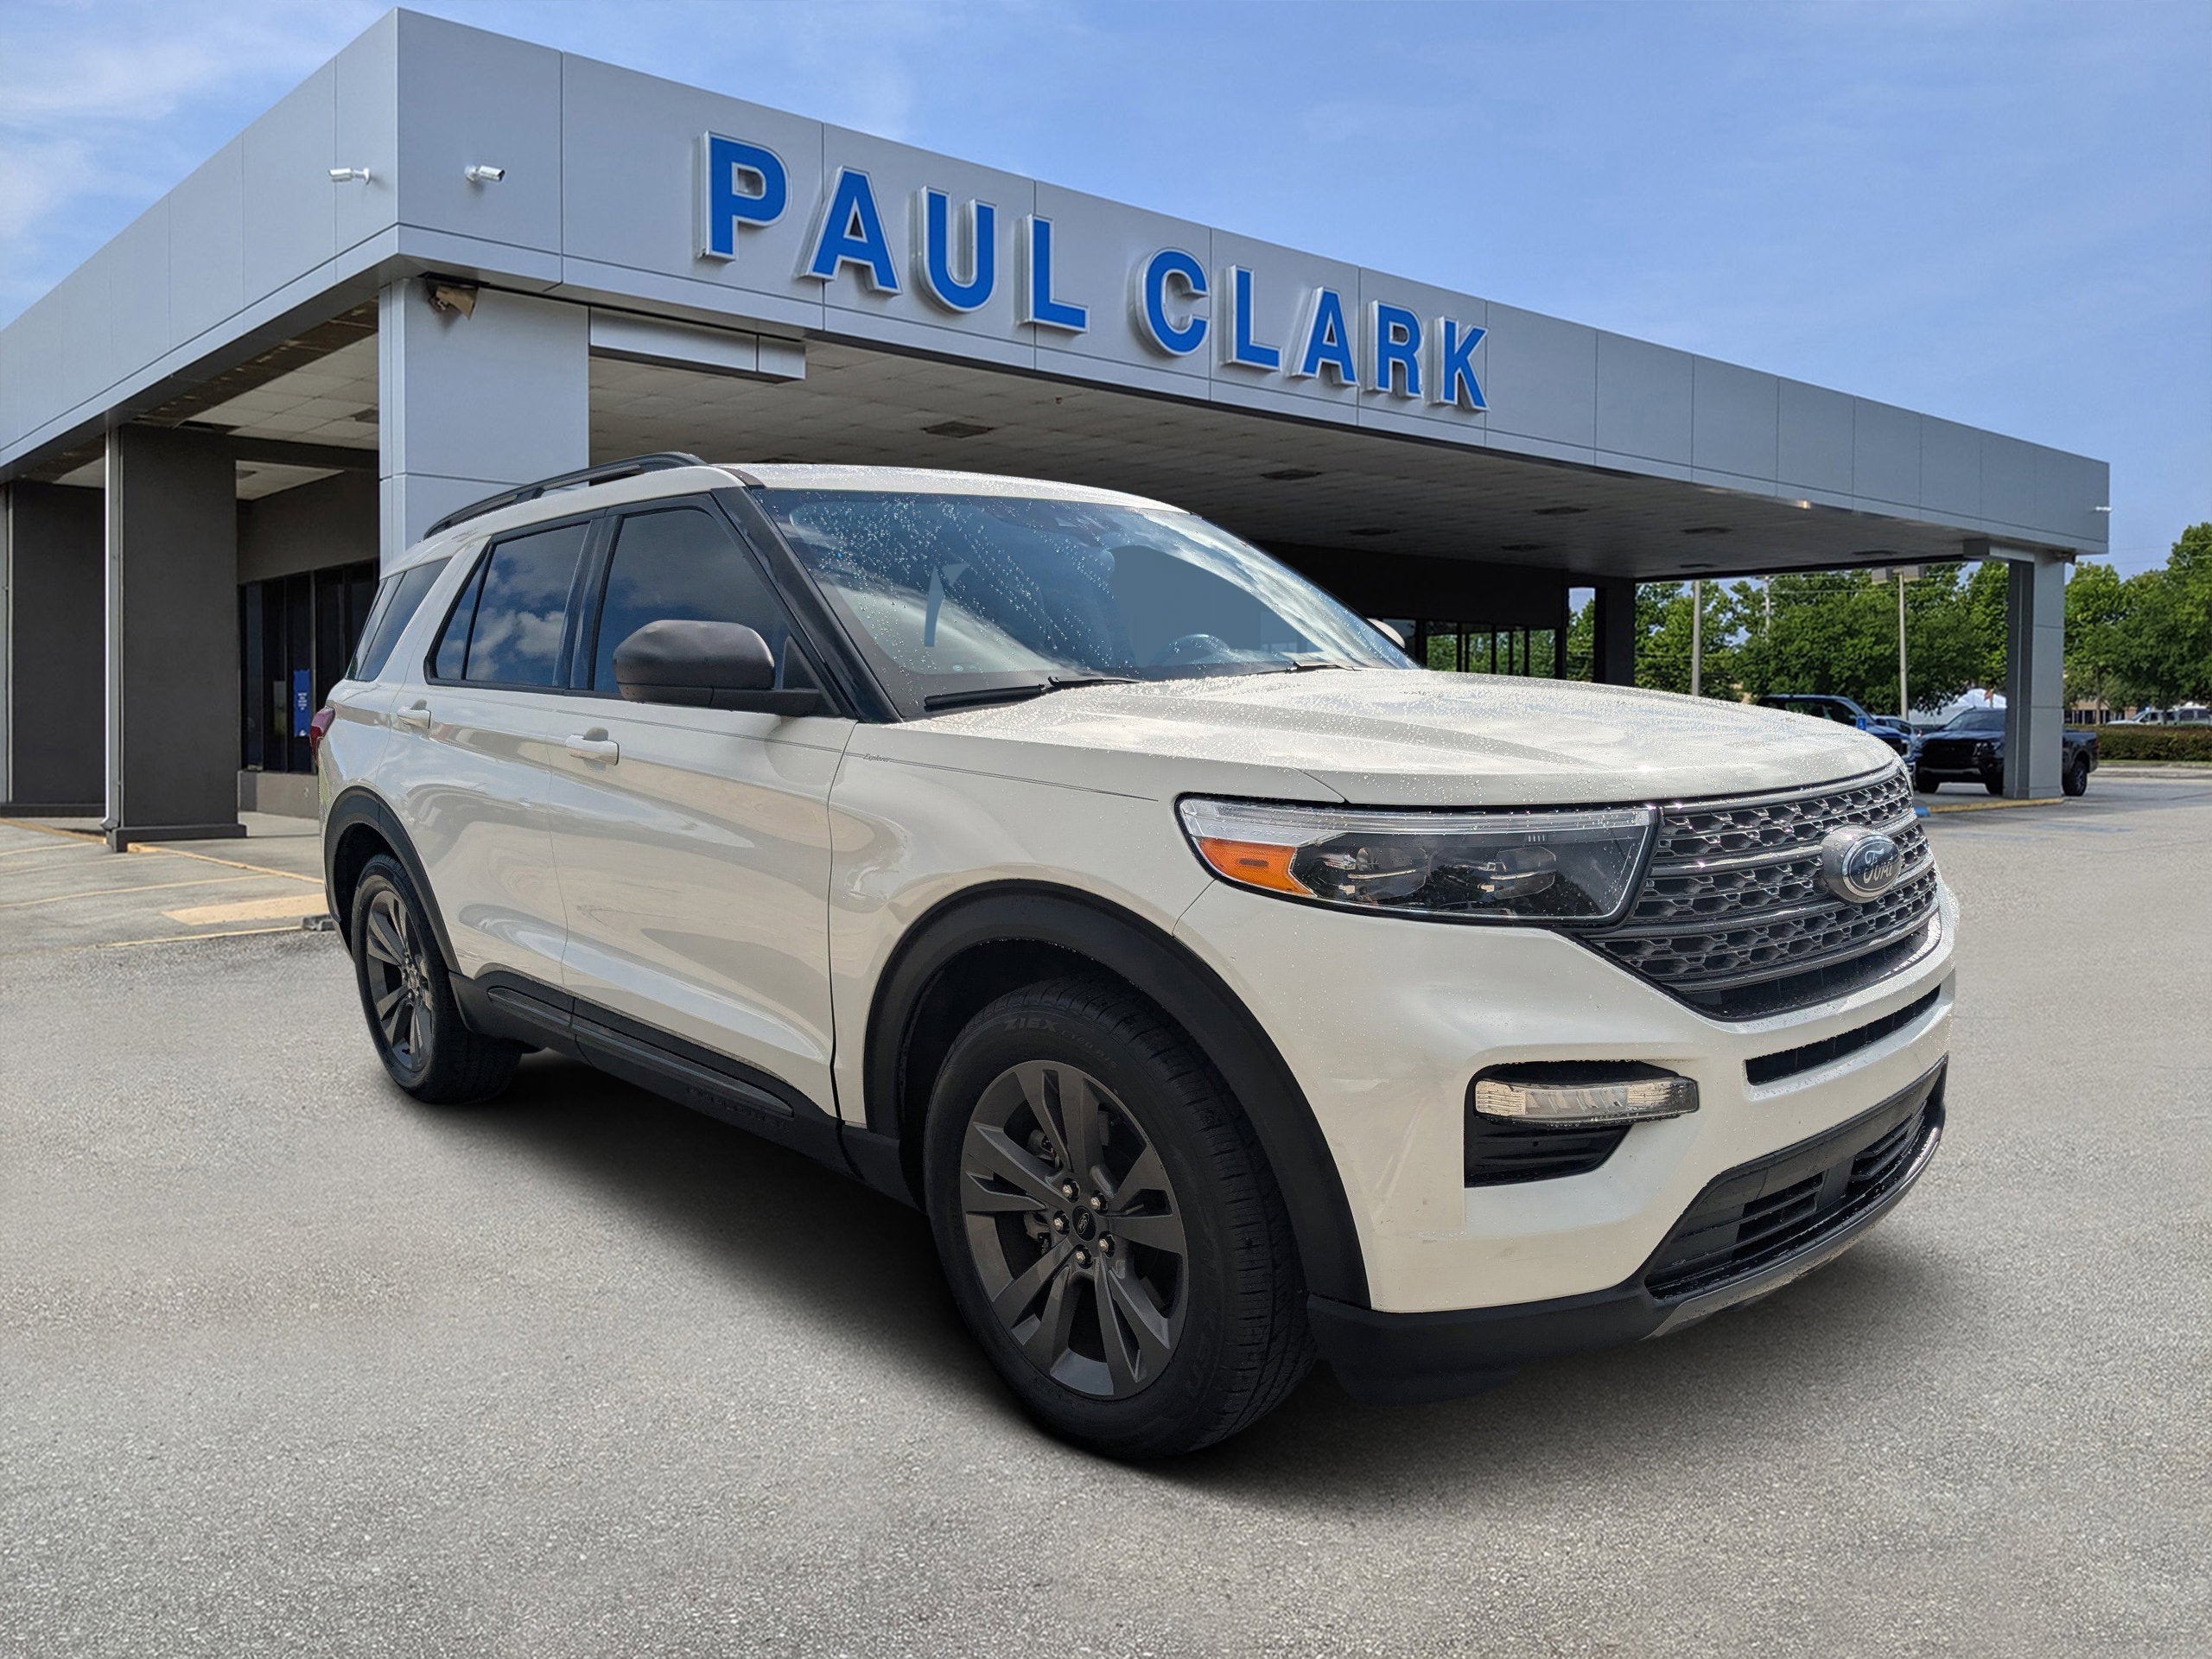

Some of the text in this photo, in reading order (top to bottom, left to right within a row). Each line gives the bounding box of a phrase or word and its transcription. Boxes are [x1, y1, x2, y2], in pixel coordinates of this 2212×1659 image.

[702, 129, 1490, 412] PAUL CLARK
[1863, 848, 1894, 884] Ford
